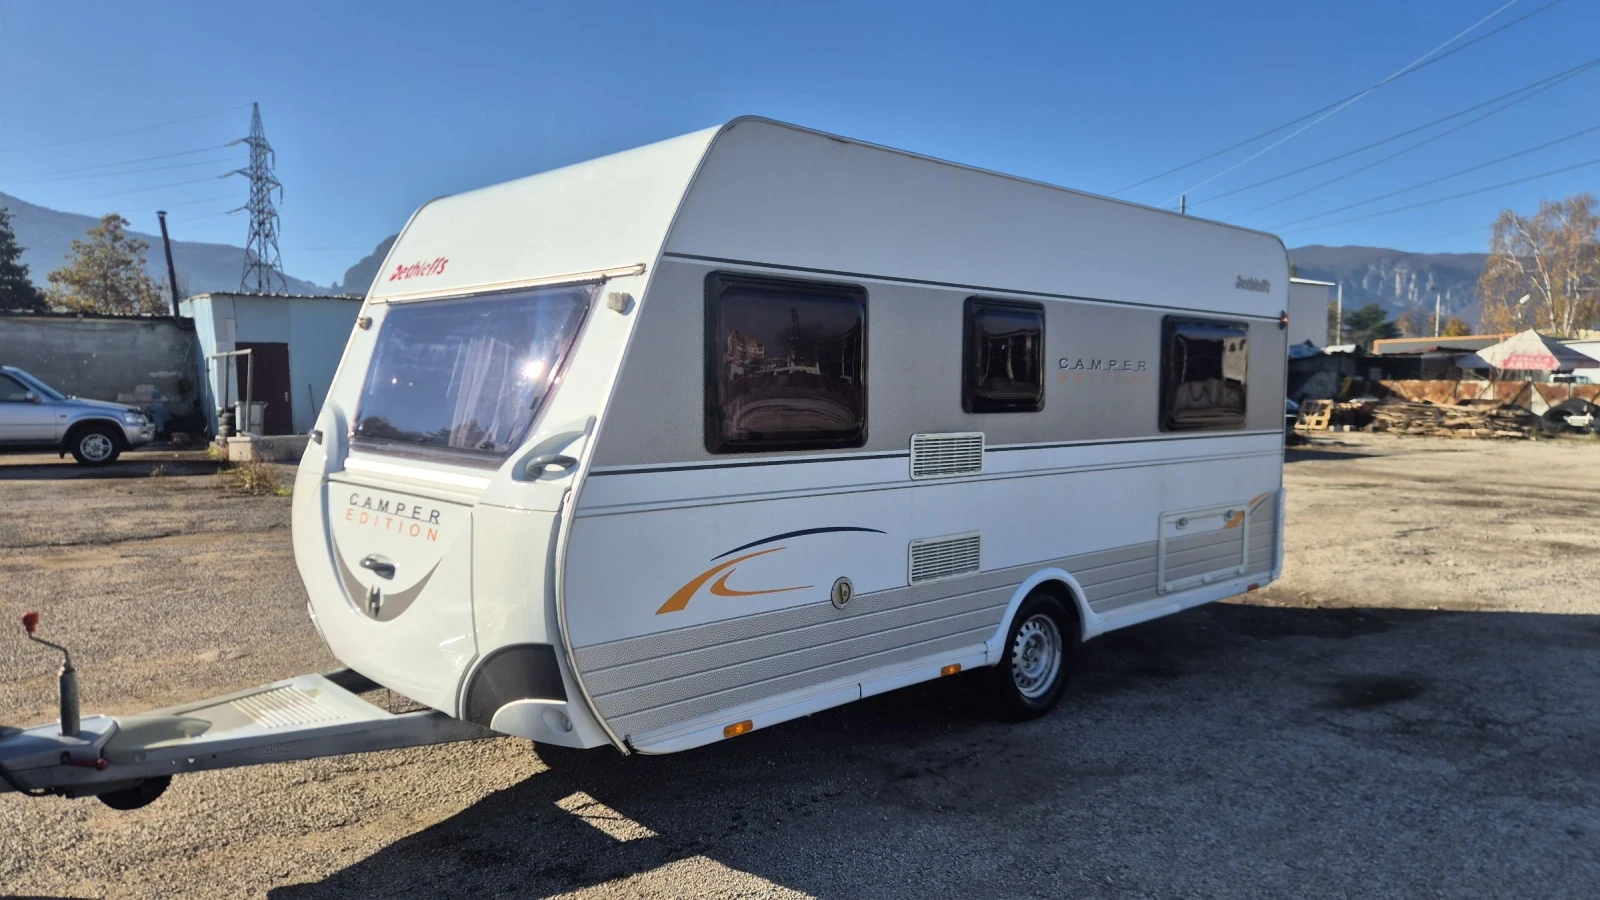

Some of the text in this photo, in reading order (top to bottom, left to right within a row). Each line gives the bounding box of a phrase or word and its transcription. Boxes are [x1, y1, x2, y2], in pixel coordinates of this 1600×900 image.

[1058, 357, 1147, 371] CAMPER
[349, 493, 440, 524] CAMPER
[346, 509, 438, 541] EDITION
